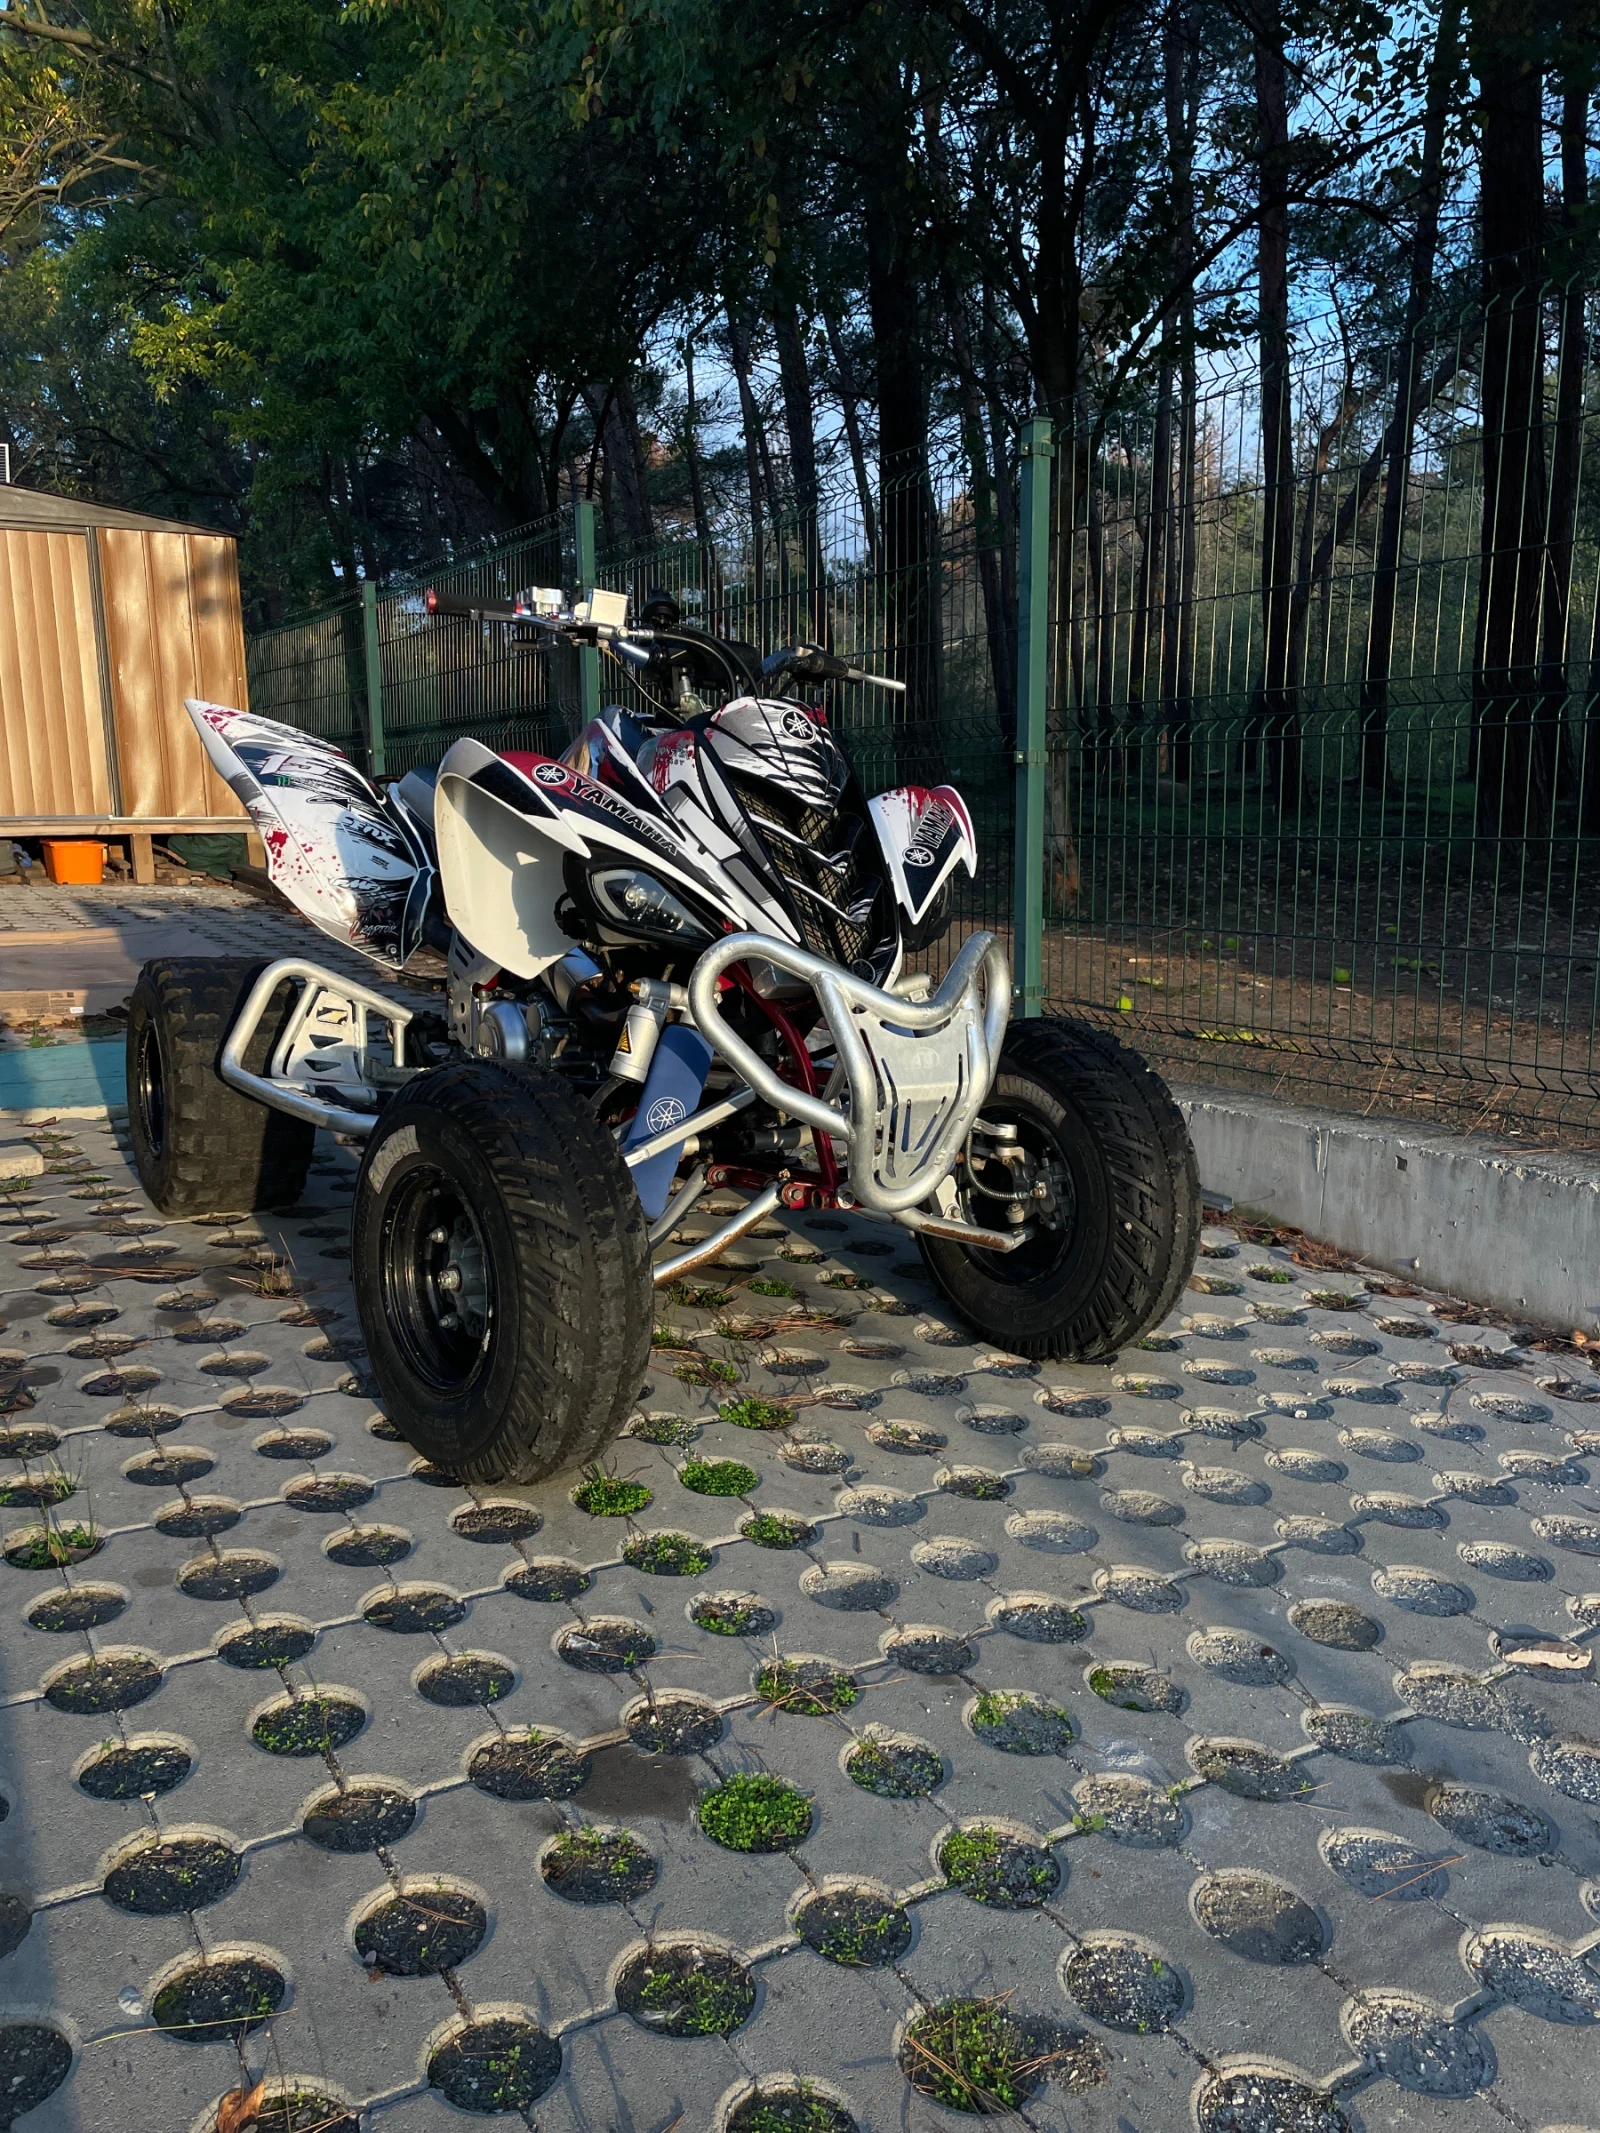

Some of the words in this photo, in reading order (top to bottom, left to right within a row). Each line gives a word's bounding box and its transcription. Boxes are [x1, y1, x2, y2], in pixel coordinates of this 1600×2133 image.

[570, 777, 679, 856] YAMAHA
[912, 799, 955, 849] YAMAHA
[360, 922, 399, 936] RAPTOR
[997, 1074, 1067, 1128] AMBUSH
[368, 1125, 421, 1194] AMBUSH
